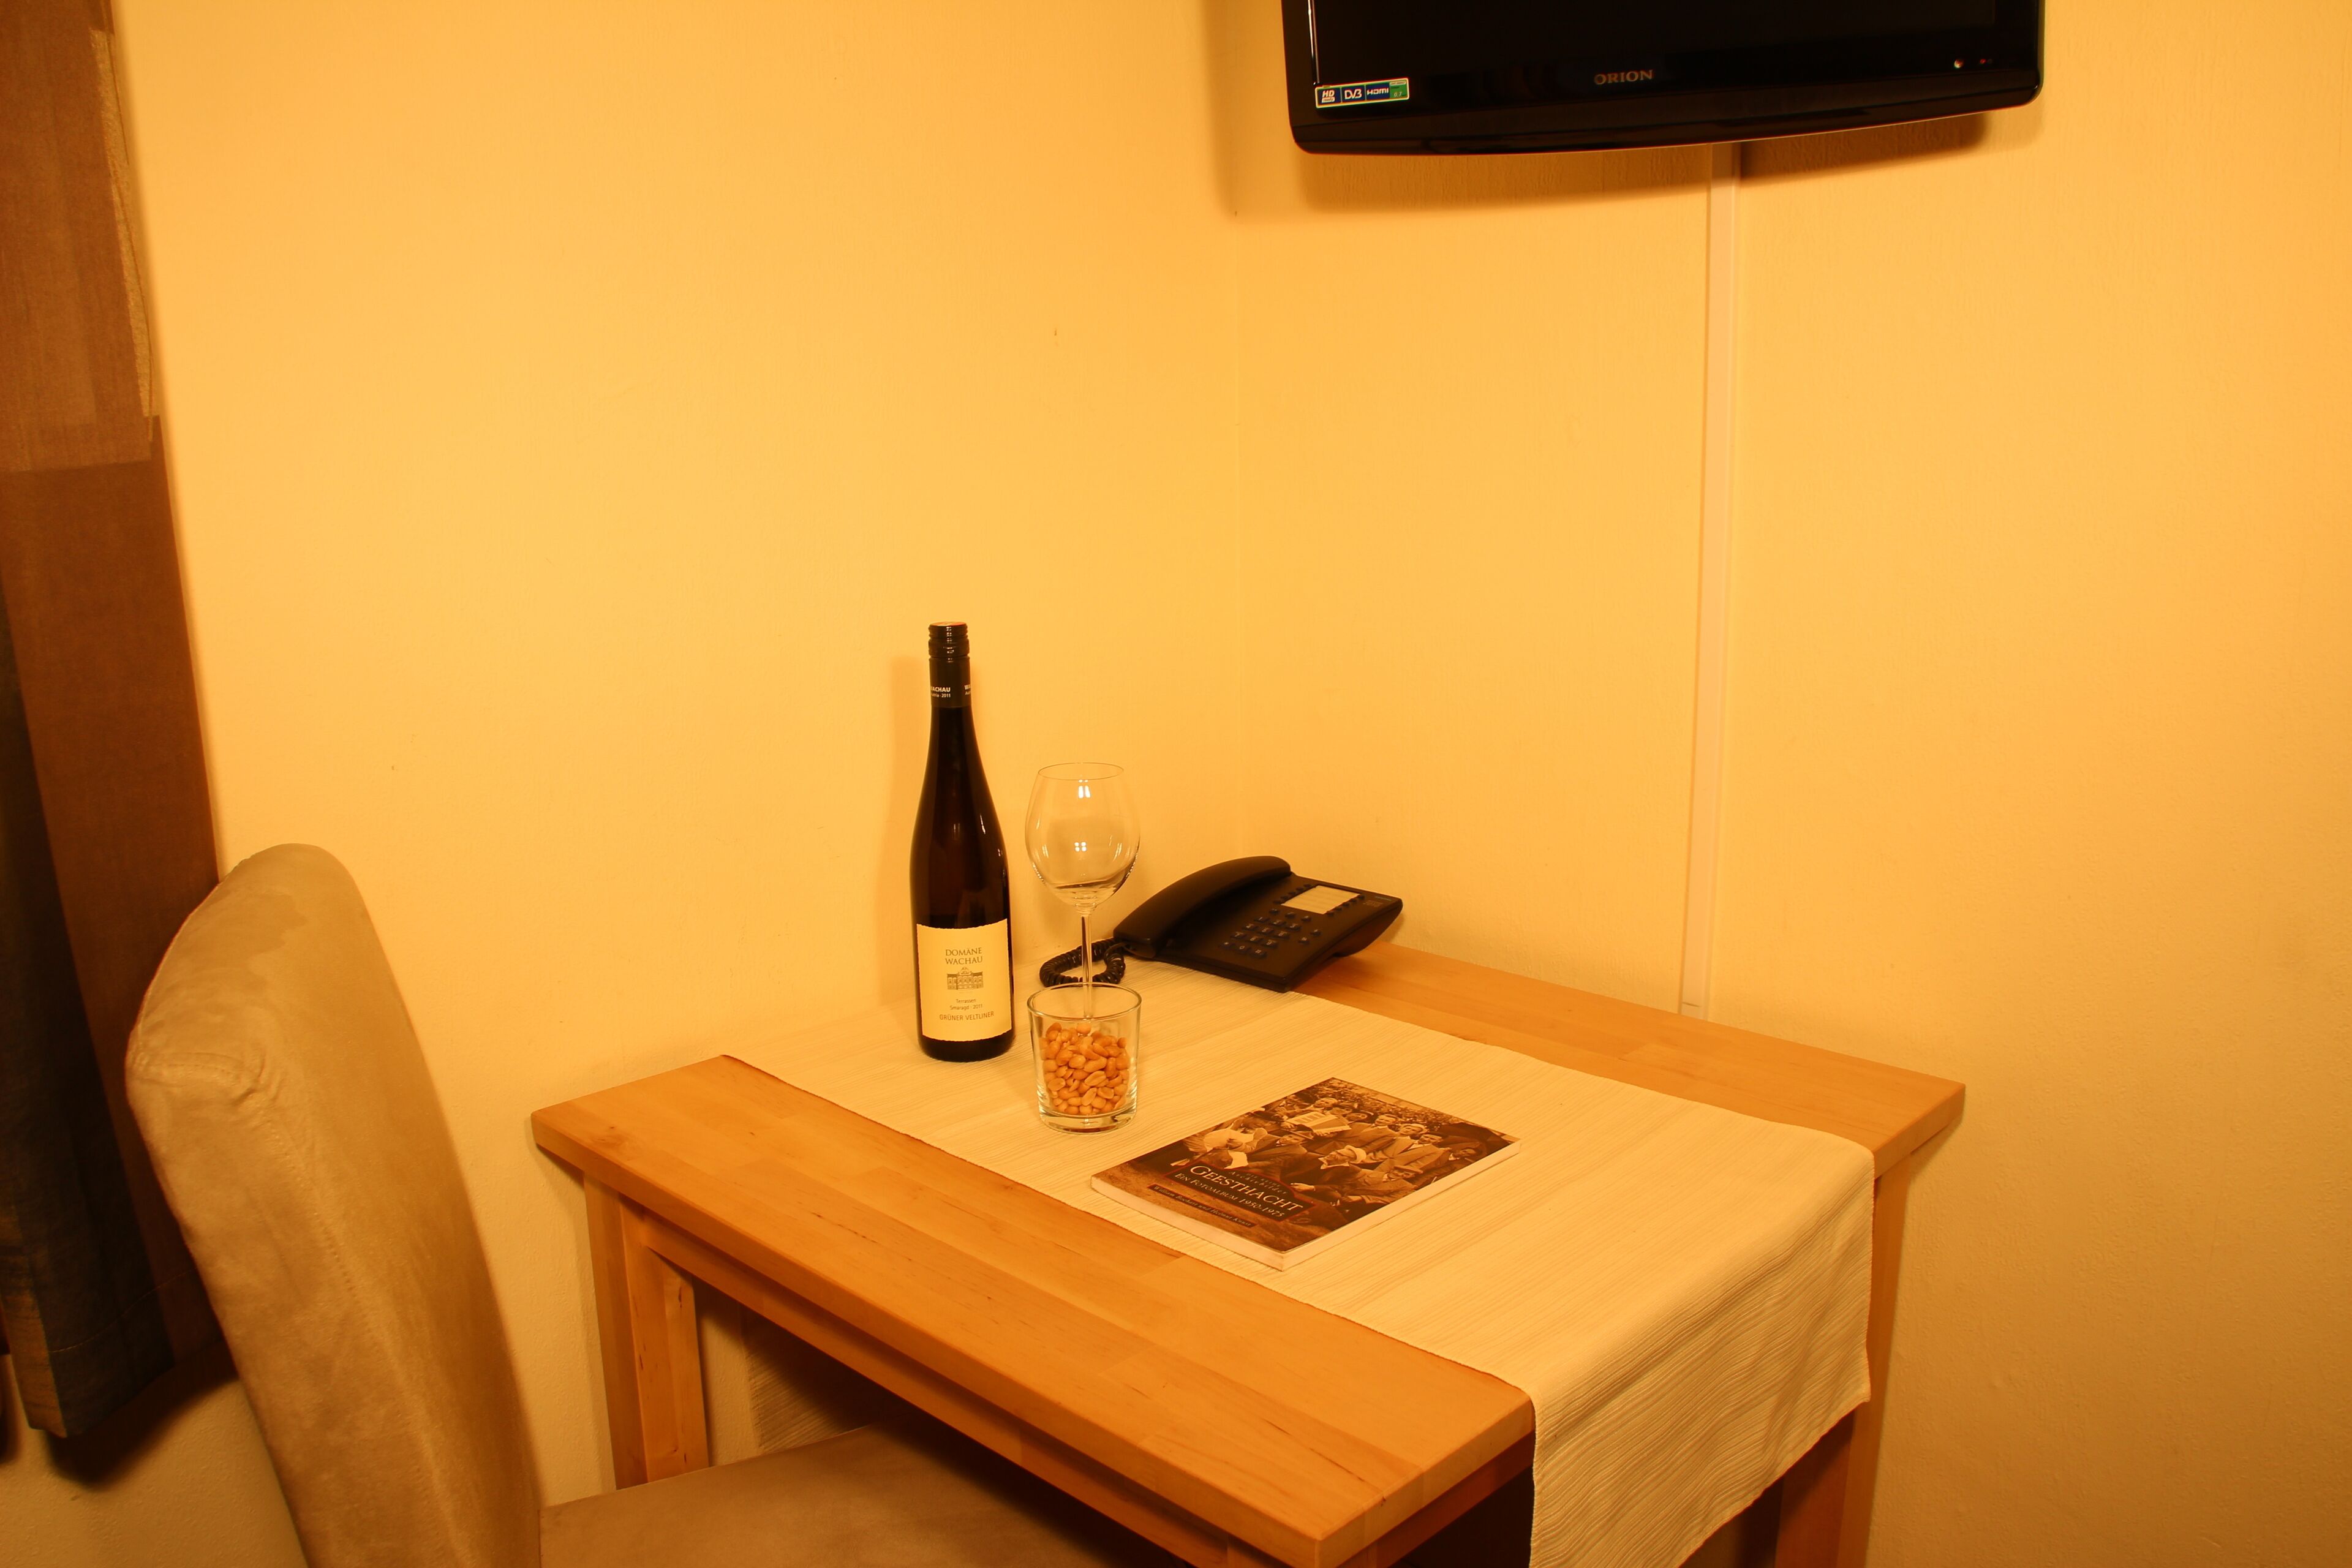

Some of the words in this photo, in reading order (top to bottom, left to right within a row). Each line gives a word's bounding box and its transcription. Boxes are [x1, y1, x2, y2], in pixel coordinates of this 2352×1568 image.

[1594, 69, 1653, 85] ORION
[1322, 89, 1335, 98] HD
[1344, 88, 1362, 100] DVB
[945, 956, 983, 965] WACHAU
[965, 1011, 995, 1021] VELTLINER
[1189, 1165, 1304, 1212] GEESTHACHT
[1174, 1172, 1192, 1182] EIN
[1189, 1178, 1238, 1202] FOTOALBUM
[1238, 1197, 1285, 1218] 1950-1975
